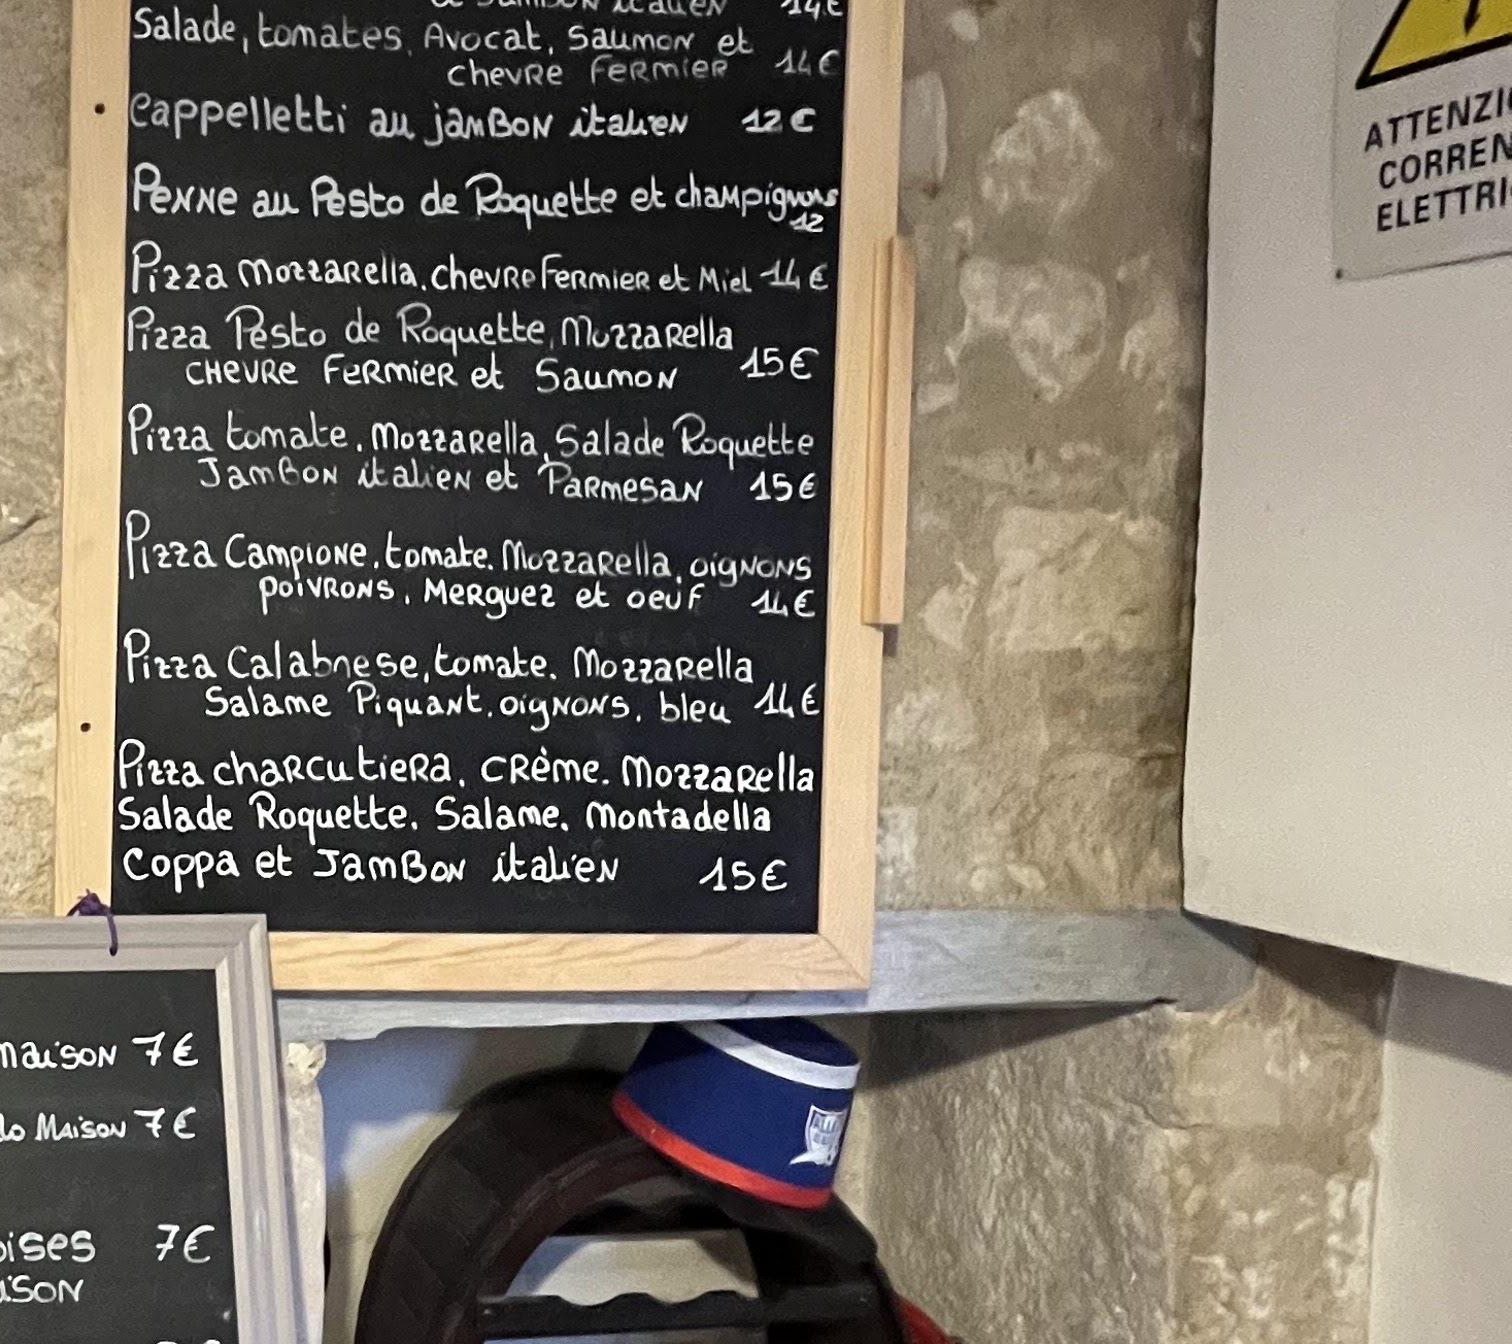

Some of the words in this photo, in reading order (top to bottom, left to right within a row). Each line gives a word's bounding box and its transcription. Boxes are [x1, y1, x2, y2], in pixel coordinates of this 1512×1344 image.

[717, 24, 755, 55] et
[369, 108, 416, 140] au
[1364, 87, 1512, 154] ATTENZI
[252, 189, 300, 219] au
[310, 174, 405, 219] Pesto
[420, 178, 461, 217] de
[464, 172, 618, 231] Roquette
[630, 173, 668, 213] et
[1377, 176, 1512, 233] ELETTRI
[131, 239, 230, 295] Pizza
[658, 261, 691, 292] et
[698, 265, 753, 294] Miel
[127, 305, 211, 353] Pizza
[225, 304, 327, 352] Pesto
[344, 306, 381, 344] de
[470, 350, 505, 391] et
[738, 346, 821, 381] 15€
[128, 403, 215, 456] Pizza
[554, 417, 666, 459] Salade
[672, 412, 815, 472] Roquette
[485, 457, 519, 492] et
[749, 470, 818, 503] 15€
[125, 509, 218, 580] Pizza
[575, 579, 610, 610] et
[123, 628, 217, 684] Pizza
[204, 685, 332, 718] Salame
[659, 690, 732, 725] bleu
[118, 738, 205, 790] Pizza
[118, 794, 233, 833] Salade
[123, 846, 240, 894] Coppa
[254, 844, 293, 879] et
[698, 856, 789, 893] 15€
[131, 1031, 199, 1067] 7€
[133, 1106, 197, 1140] 7€
[155, 1223, 216, 1264] 7€
